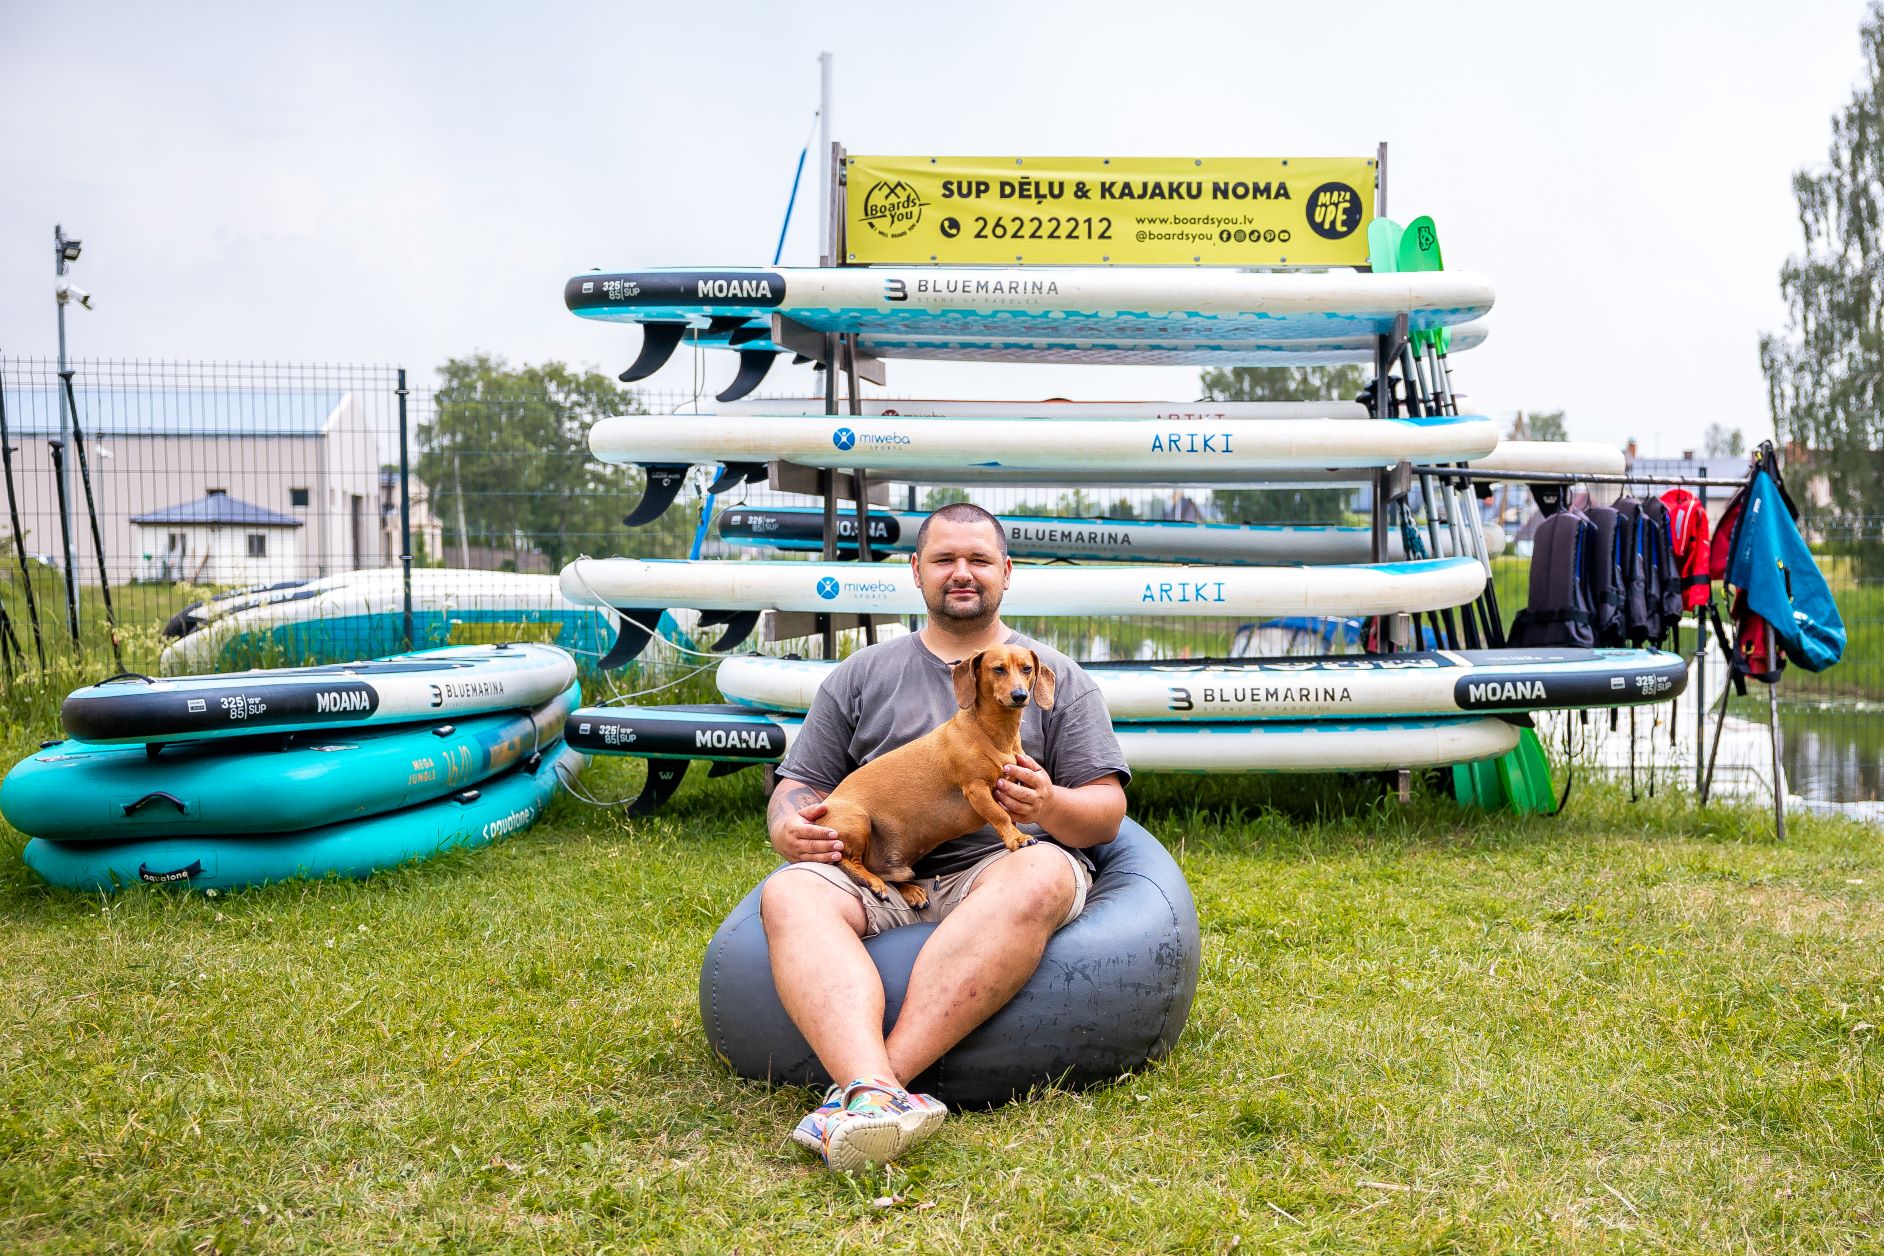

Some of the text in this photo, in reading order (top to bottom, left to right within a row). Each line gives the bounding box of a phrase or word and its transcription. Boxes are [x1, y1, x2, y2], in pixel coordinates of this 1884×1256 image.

[941, 176, 1292, 205] SUP DĒĻU & KAJAKU NOMA
[870, 193, 917, 216] Boards
[889, 210, 913, 228] You
[1135, 214, 1255, 228] www.boardsyou.lv
[1314, 202, 1351, 232] UPE
[974, 216, 1112, 240] 26222212
[1135, 230, 1213, 243] @boardsyou
[602, 281, 621, 291] 325
[624, 287, 640, 297] SUP
[697, 280, 771, 298] MOANA
[917, 279, 1059, 295] BLUEMARINA
[609, 290, 621, 300] 85
[860, 432, 911, 444] miweba
[1151, 433, 1234, 453] ARIKI
[1011, 527, 1132, 545] BLUEMARINA
[844, 580, 896, 592] miweba
[1142, 583, 1226, 602] ARIKI
[446, 681, 504, 698] BLUEMARINA
[1203, 687, 1353, 703] BLUEMARINA
[1469, 681, 1547, 703] MOANA
[221, 696, 244, 709] 325
[248, 703, 267, 715] SUP
[317, 690, 370, 713] MOANA
[230, 707, 244, 719] 85
[599, 724, 617, 735] 325
[605, 734, 617, 744] 85
[620, 733, 637, 743] SUP
[695, 730, 771, 749] MOANA
[143, 871, 188, 882] aquatone
